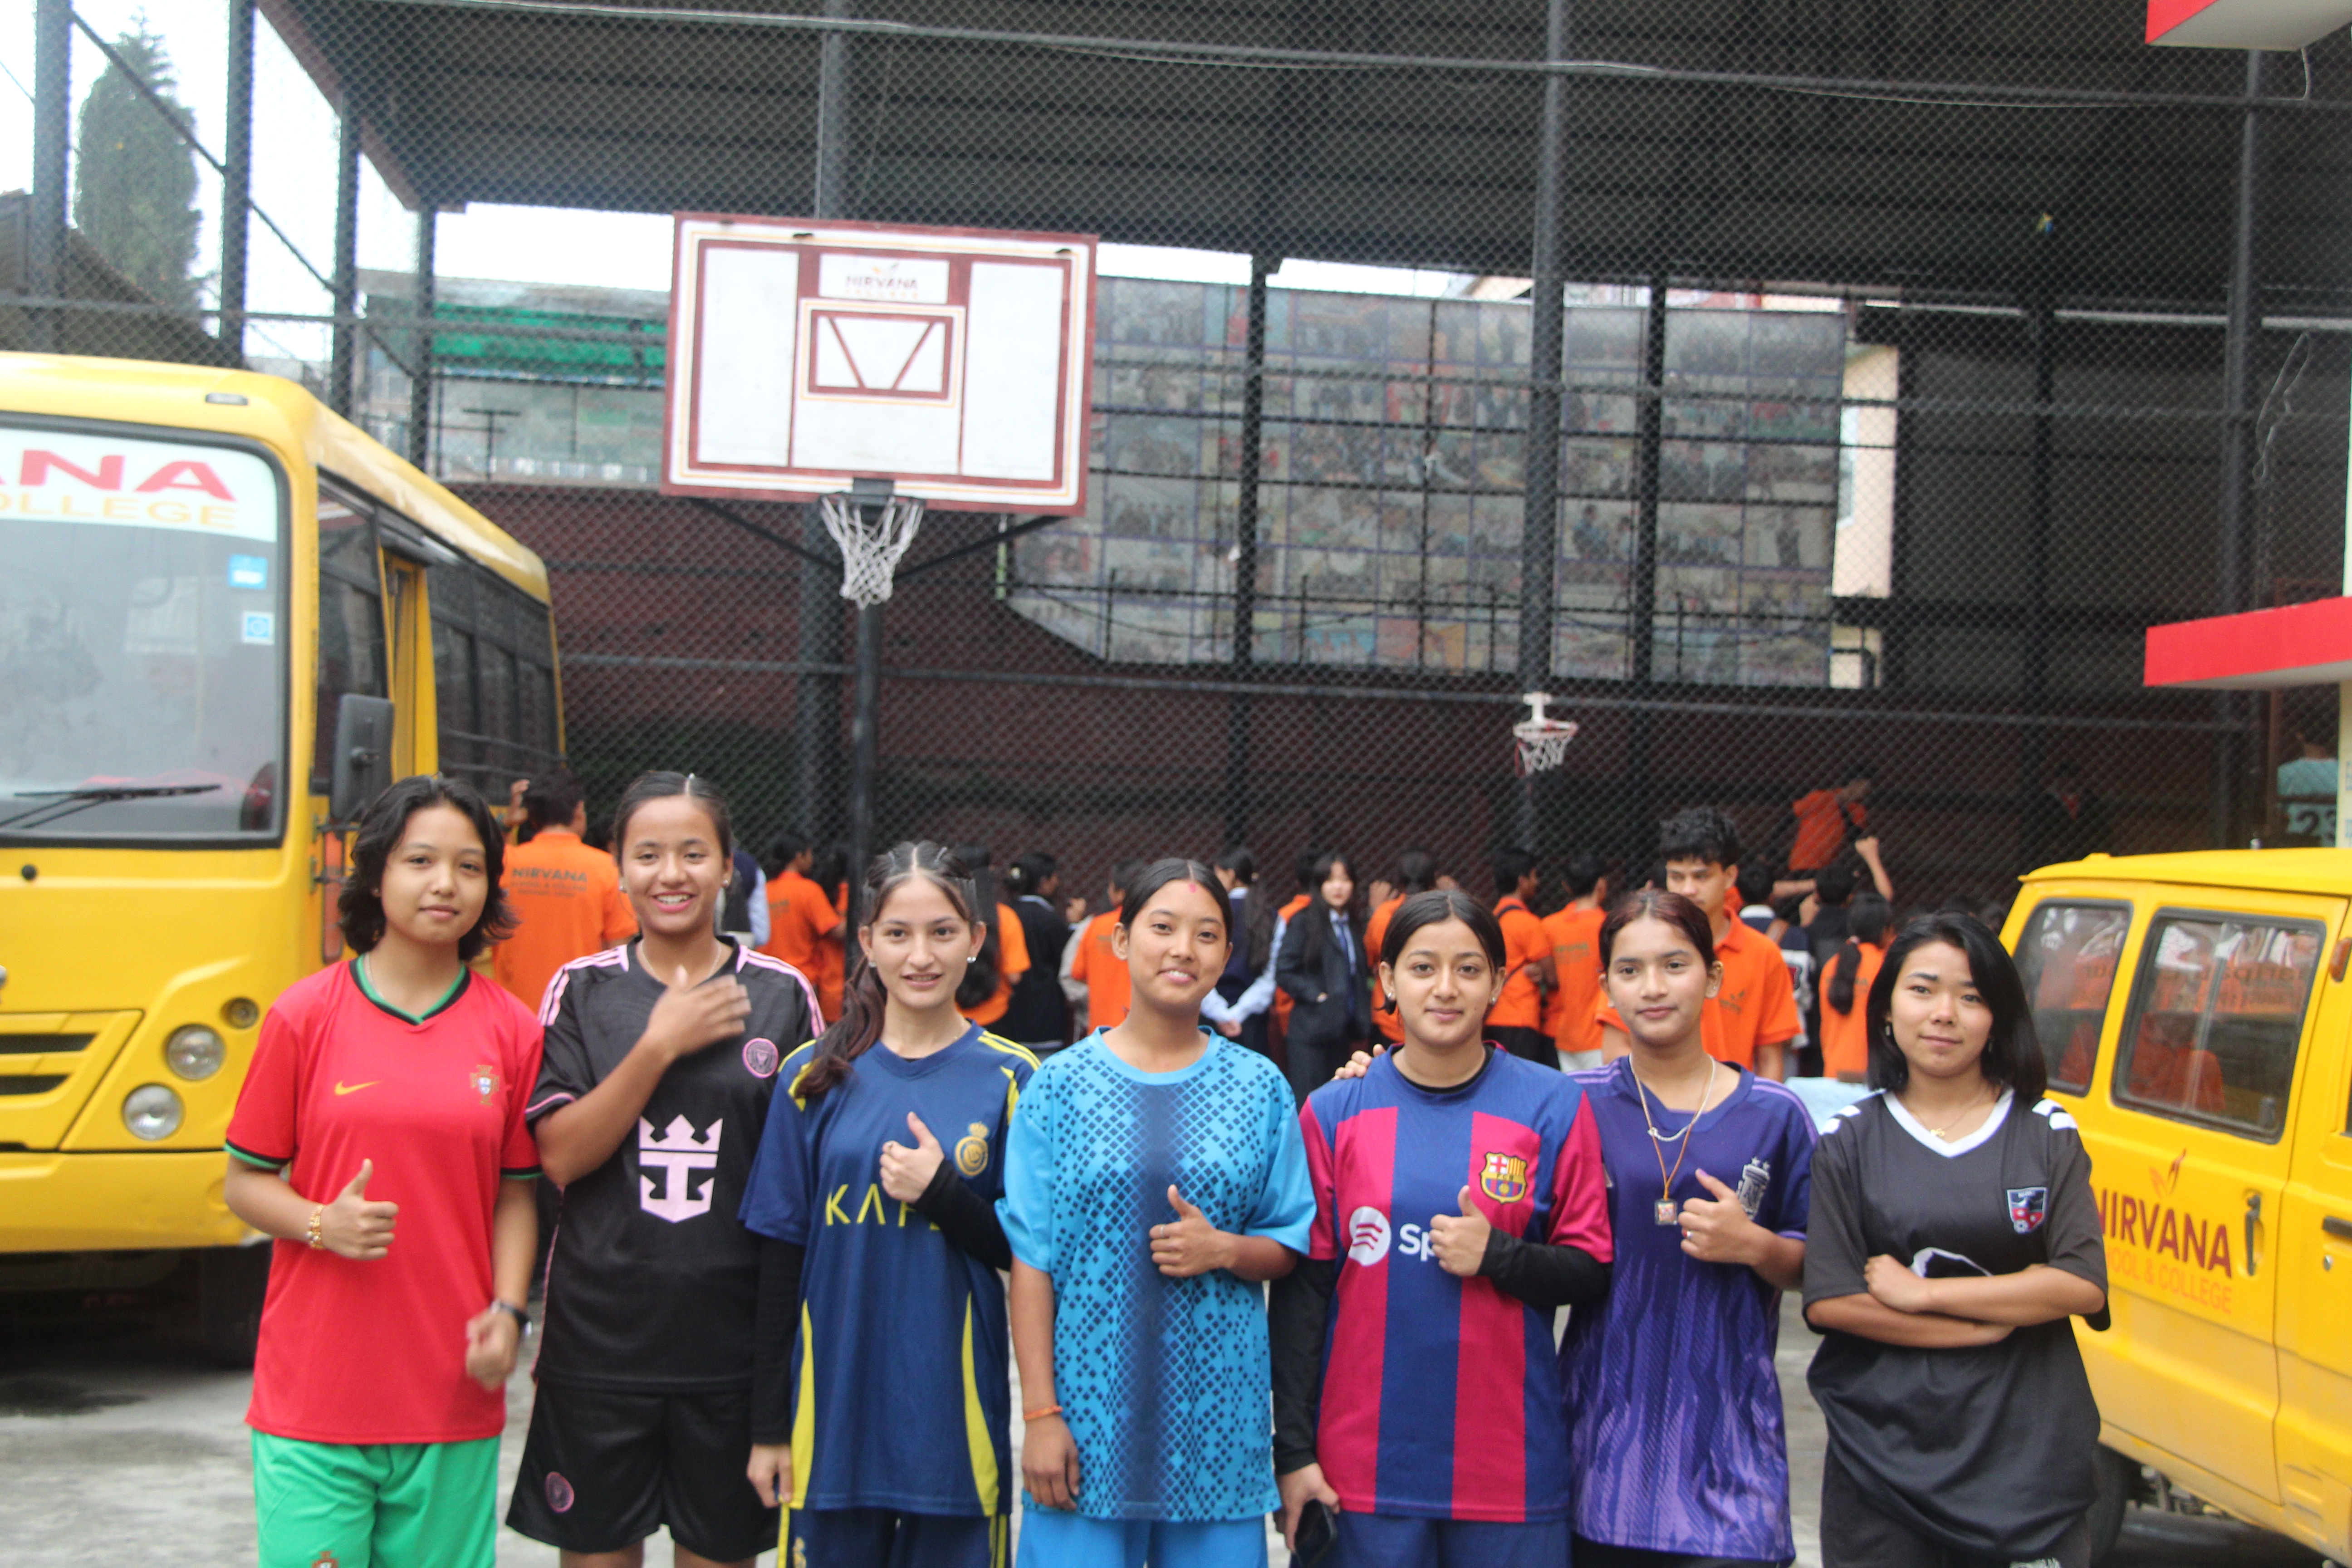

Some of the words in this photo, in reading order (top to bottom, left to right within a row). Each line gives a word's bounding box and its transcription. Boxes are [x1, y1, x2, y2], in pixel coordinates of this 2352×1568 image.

[0, 450, 237, 502] NA
[512, 867, 587, 882] NIRVANA
[2144, 1257, 2154, 1285] &
[2158, 1263, 2232, 1314] COLLEGE
